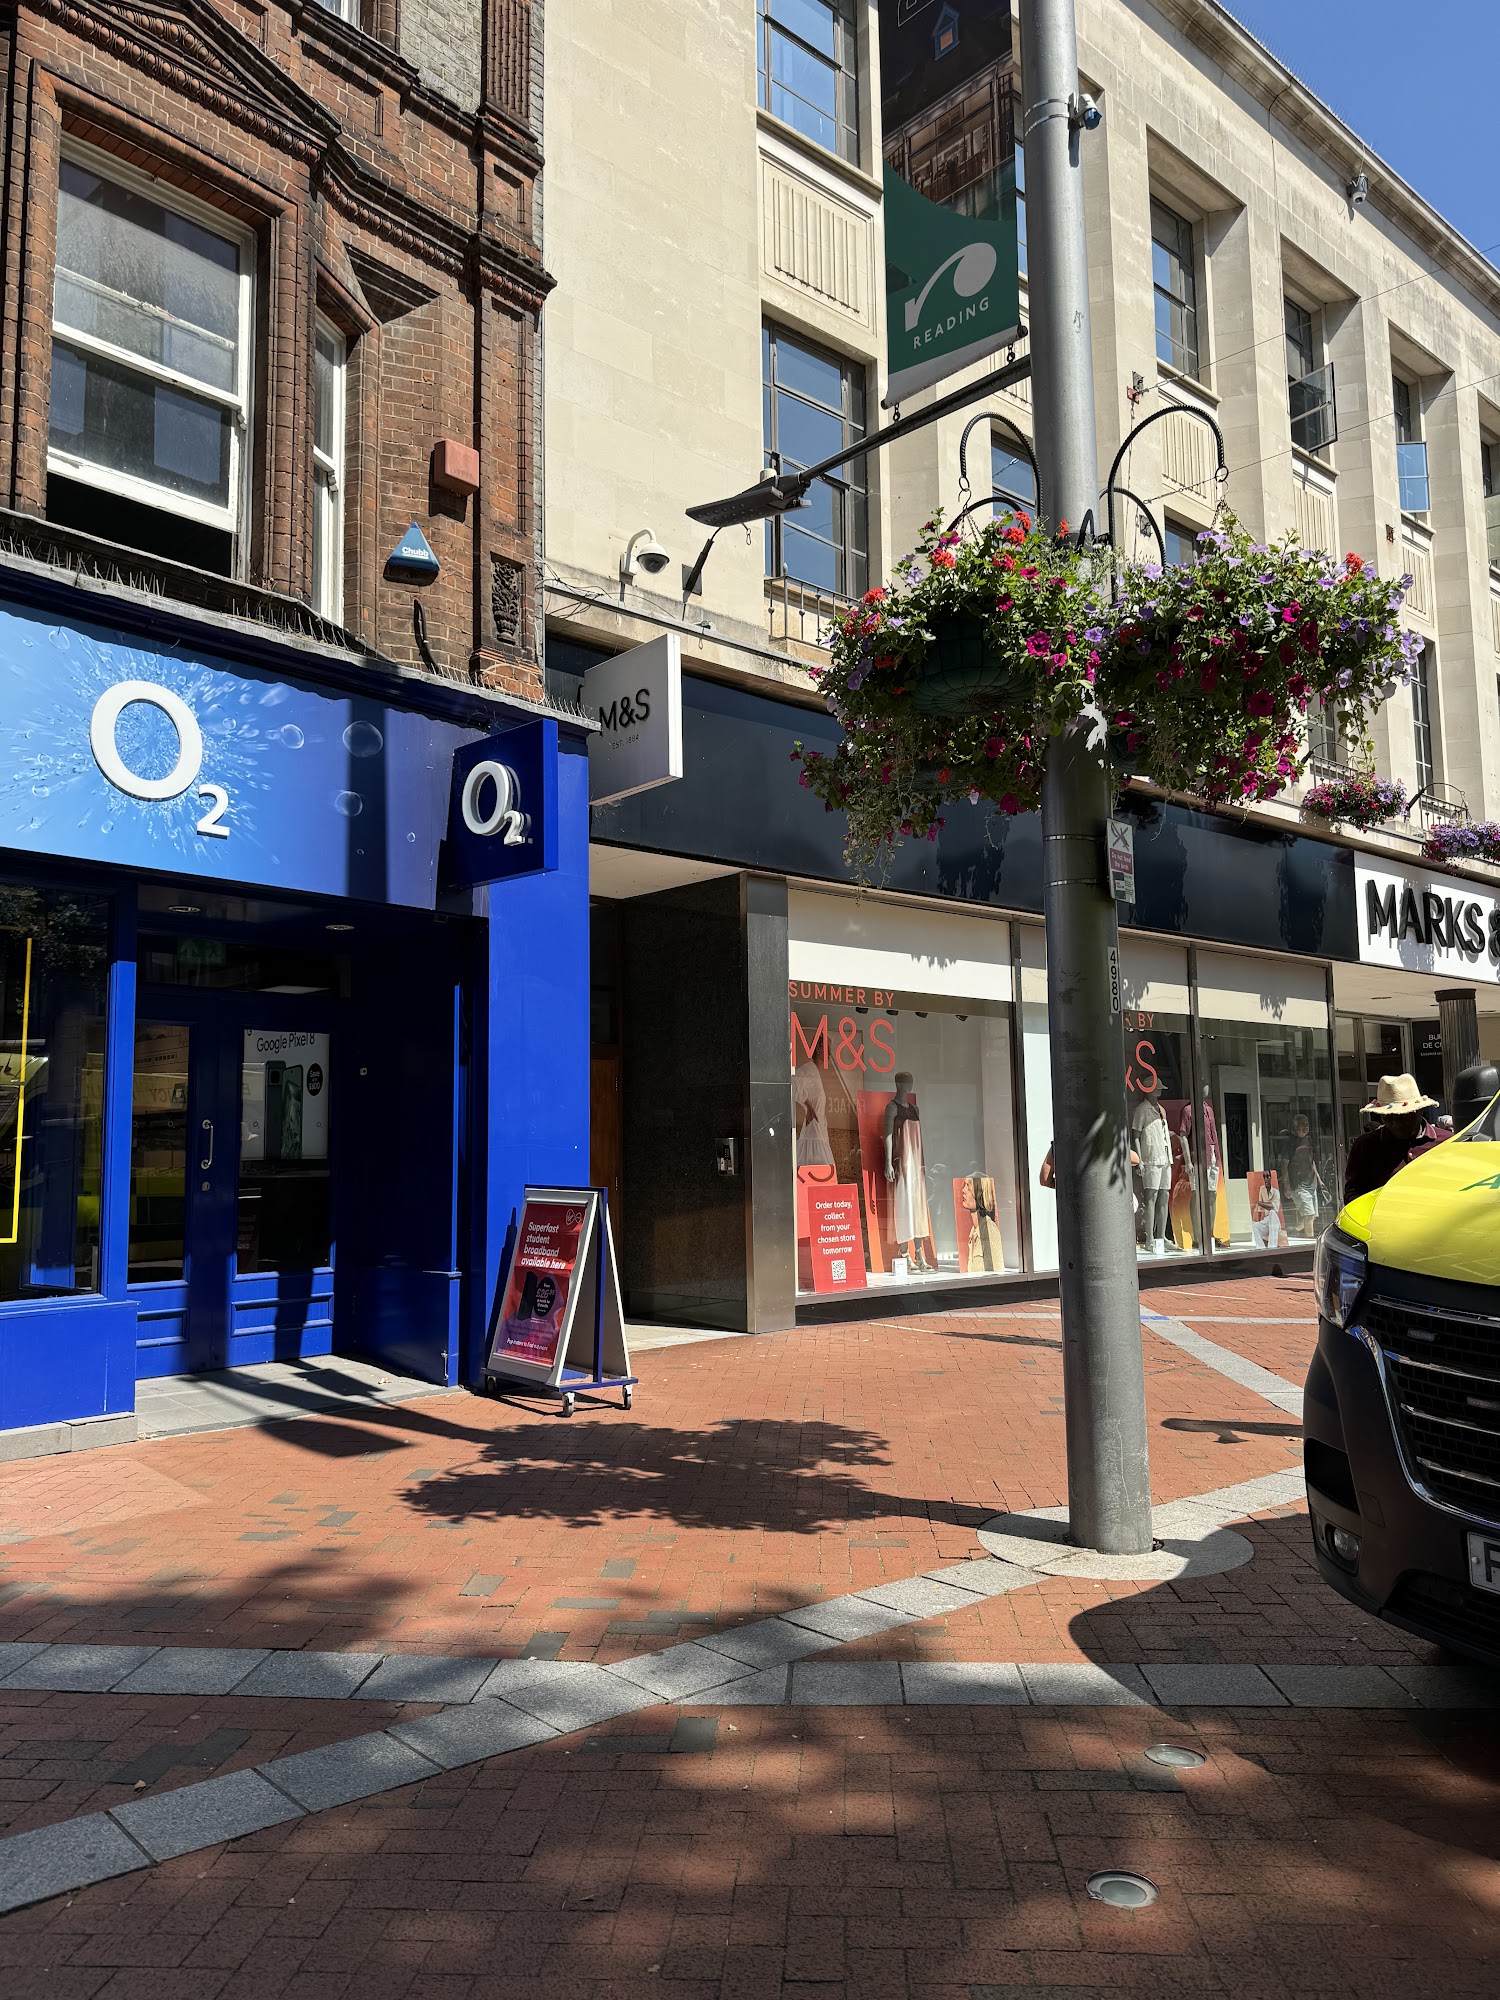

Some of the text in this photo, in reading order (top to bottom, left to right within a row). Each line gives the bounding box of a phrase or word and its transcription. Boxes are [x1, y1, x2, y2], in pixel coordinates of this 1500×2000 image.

[913, 296, 990, 350] READING
[401, 546, 429, 557] Chubb
[599, 688, 650, 737] M&S
[1366, 879, 1486, 954] MARKS
[1109, 950, 1119, 1012] 4980
[788, 981, 895, 1007] SUMMER BY
[1137, 1011, 1154, 1028] BY
[256, 1032, 316, 1054] Google Pixel 8
[790, 1011, 895, 1073] M&S
[815, 1200, 853, 1210] Order today,
[824, 1211, 845, 1221] collect
[528, 1221, 559, 1233] Superfast
[820, 1222, 851, 1233] from your
[526, 1233, 550, 1244] student
[817, 1233, 856, 1244] chosen store
[523, 1243, 560, 1257] broadband
[822, 1245, 853, 1255] tomorrow
[521, 1256, 566, 1270] available here
